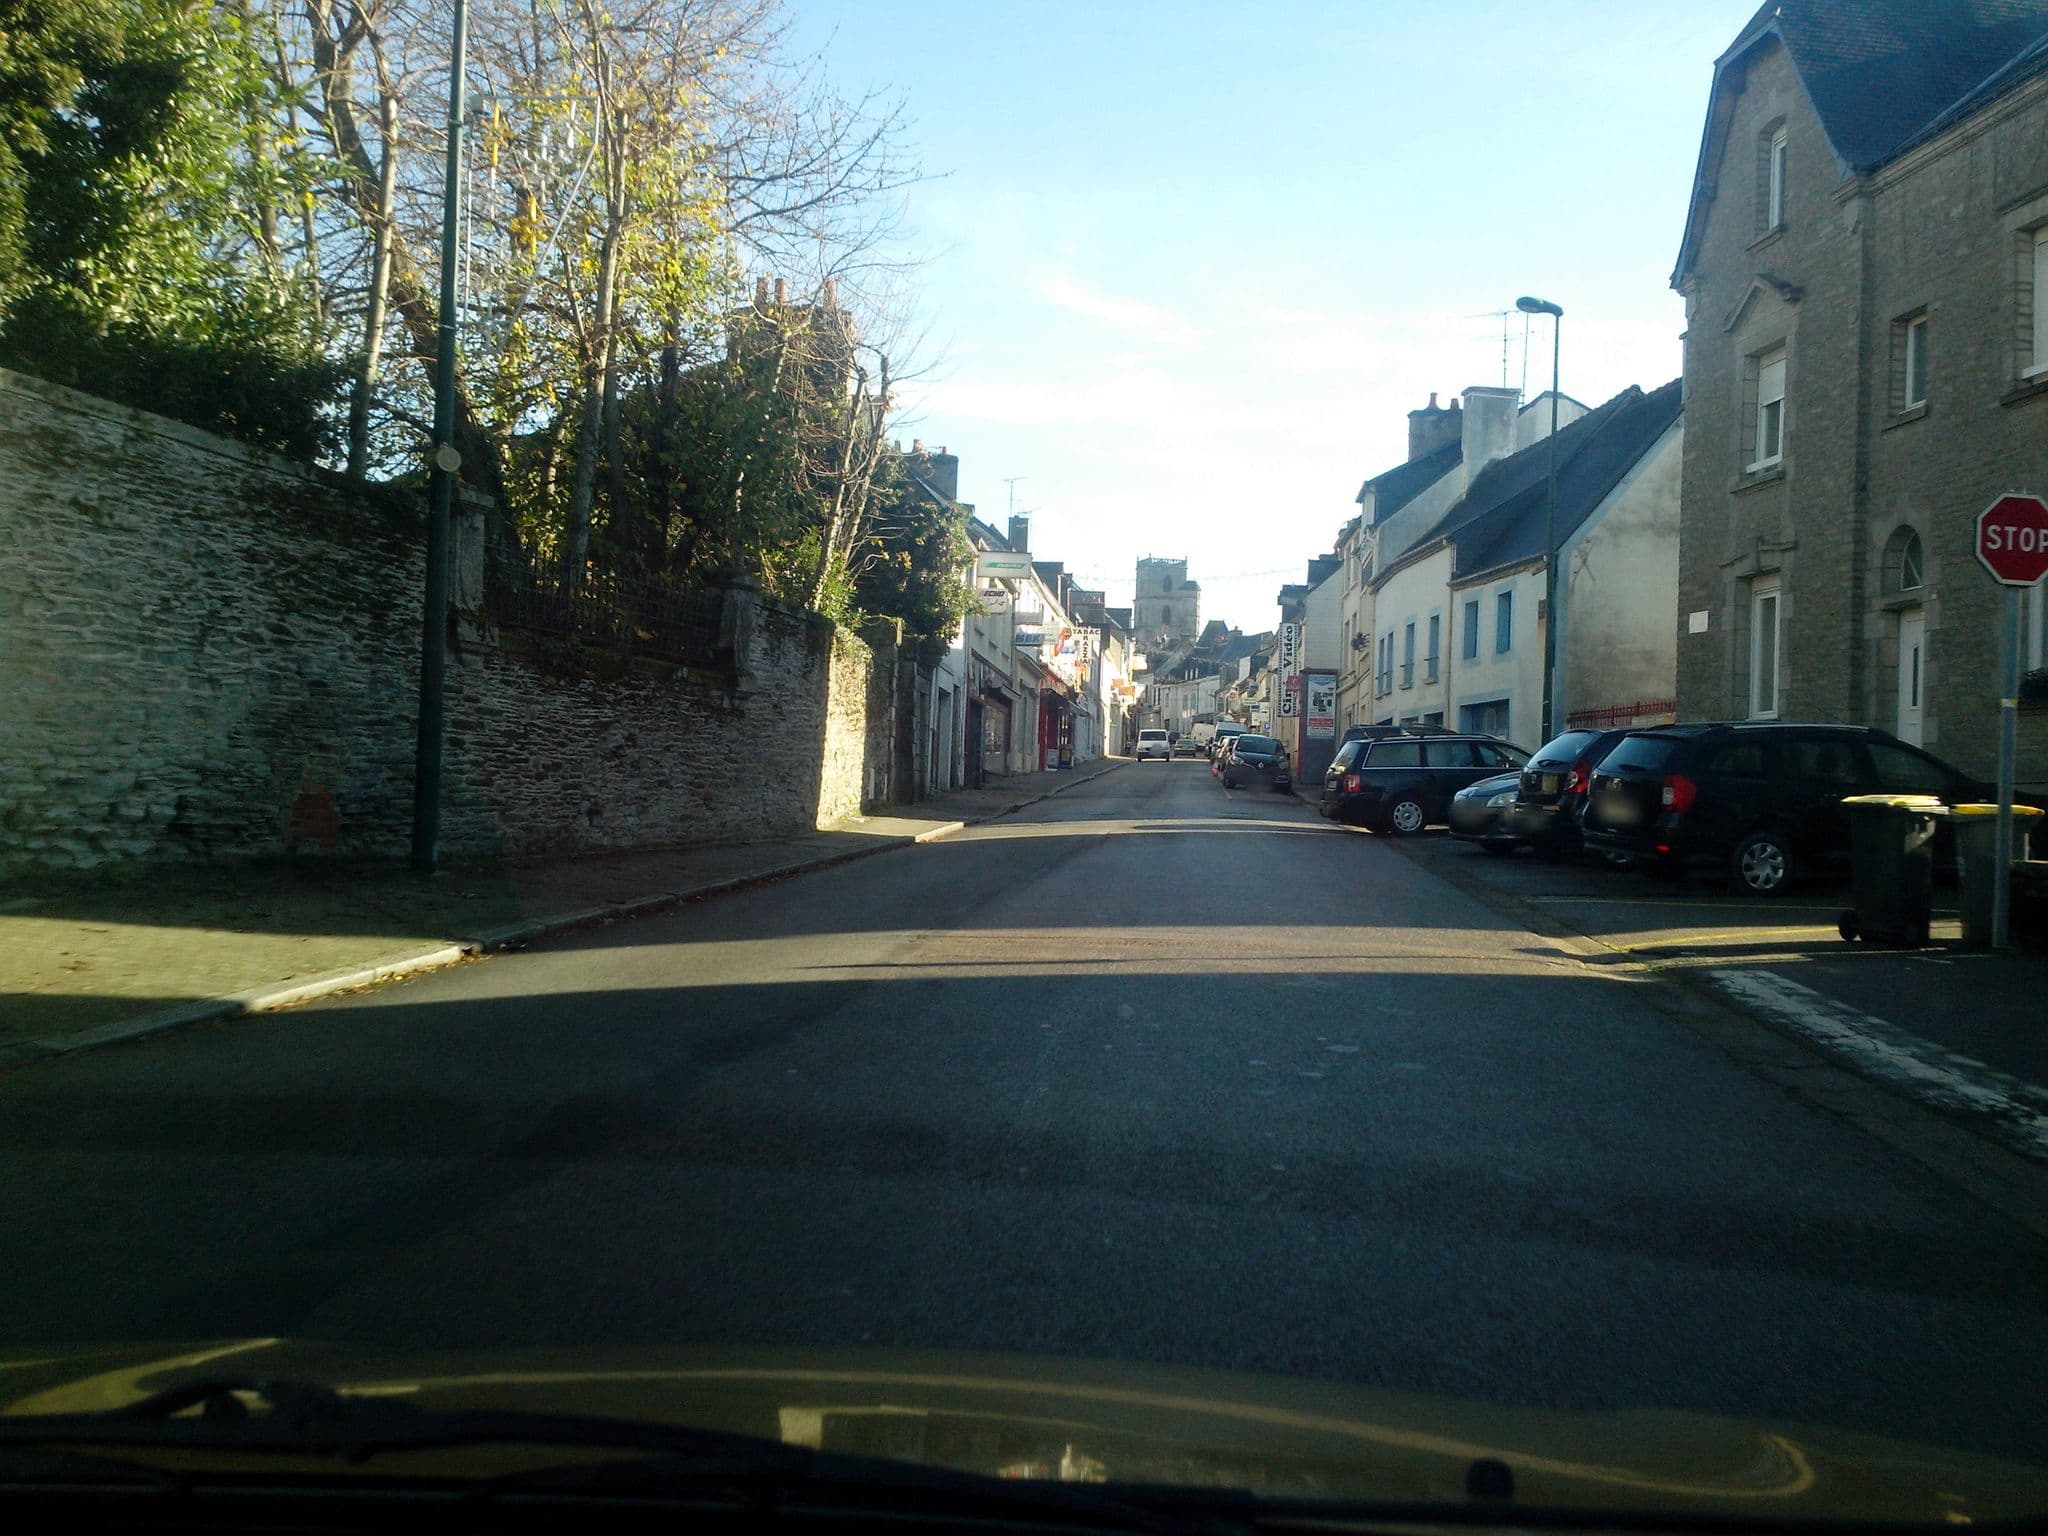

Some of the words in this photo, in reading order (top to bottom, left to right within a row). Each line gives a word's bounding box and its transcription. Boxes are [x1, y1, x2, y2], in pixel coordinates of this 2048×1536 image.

[1985, 524, 2048, 553] STOP
[1072, 628, 1100, 636] TABAC
[1283, 625, 1293, 668] Vidéo
